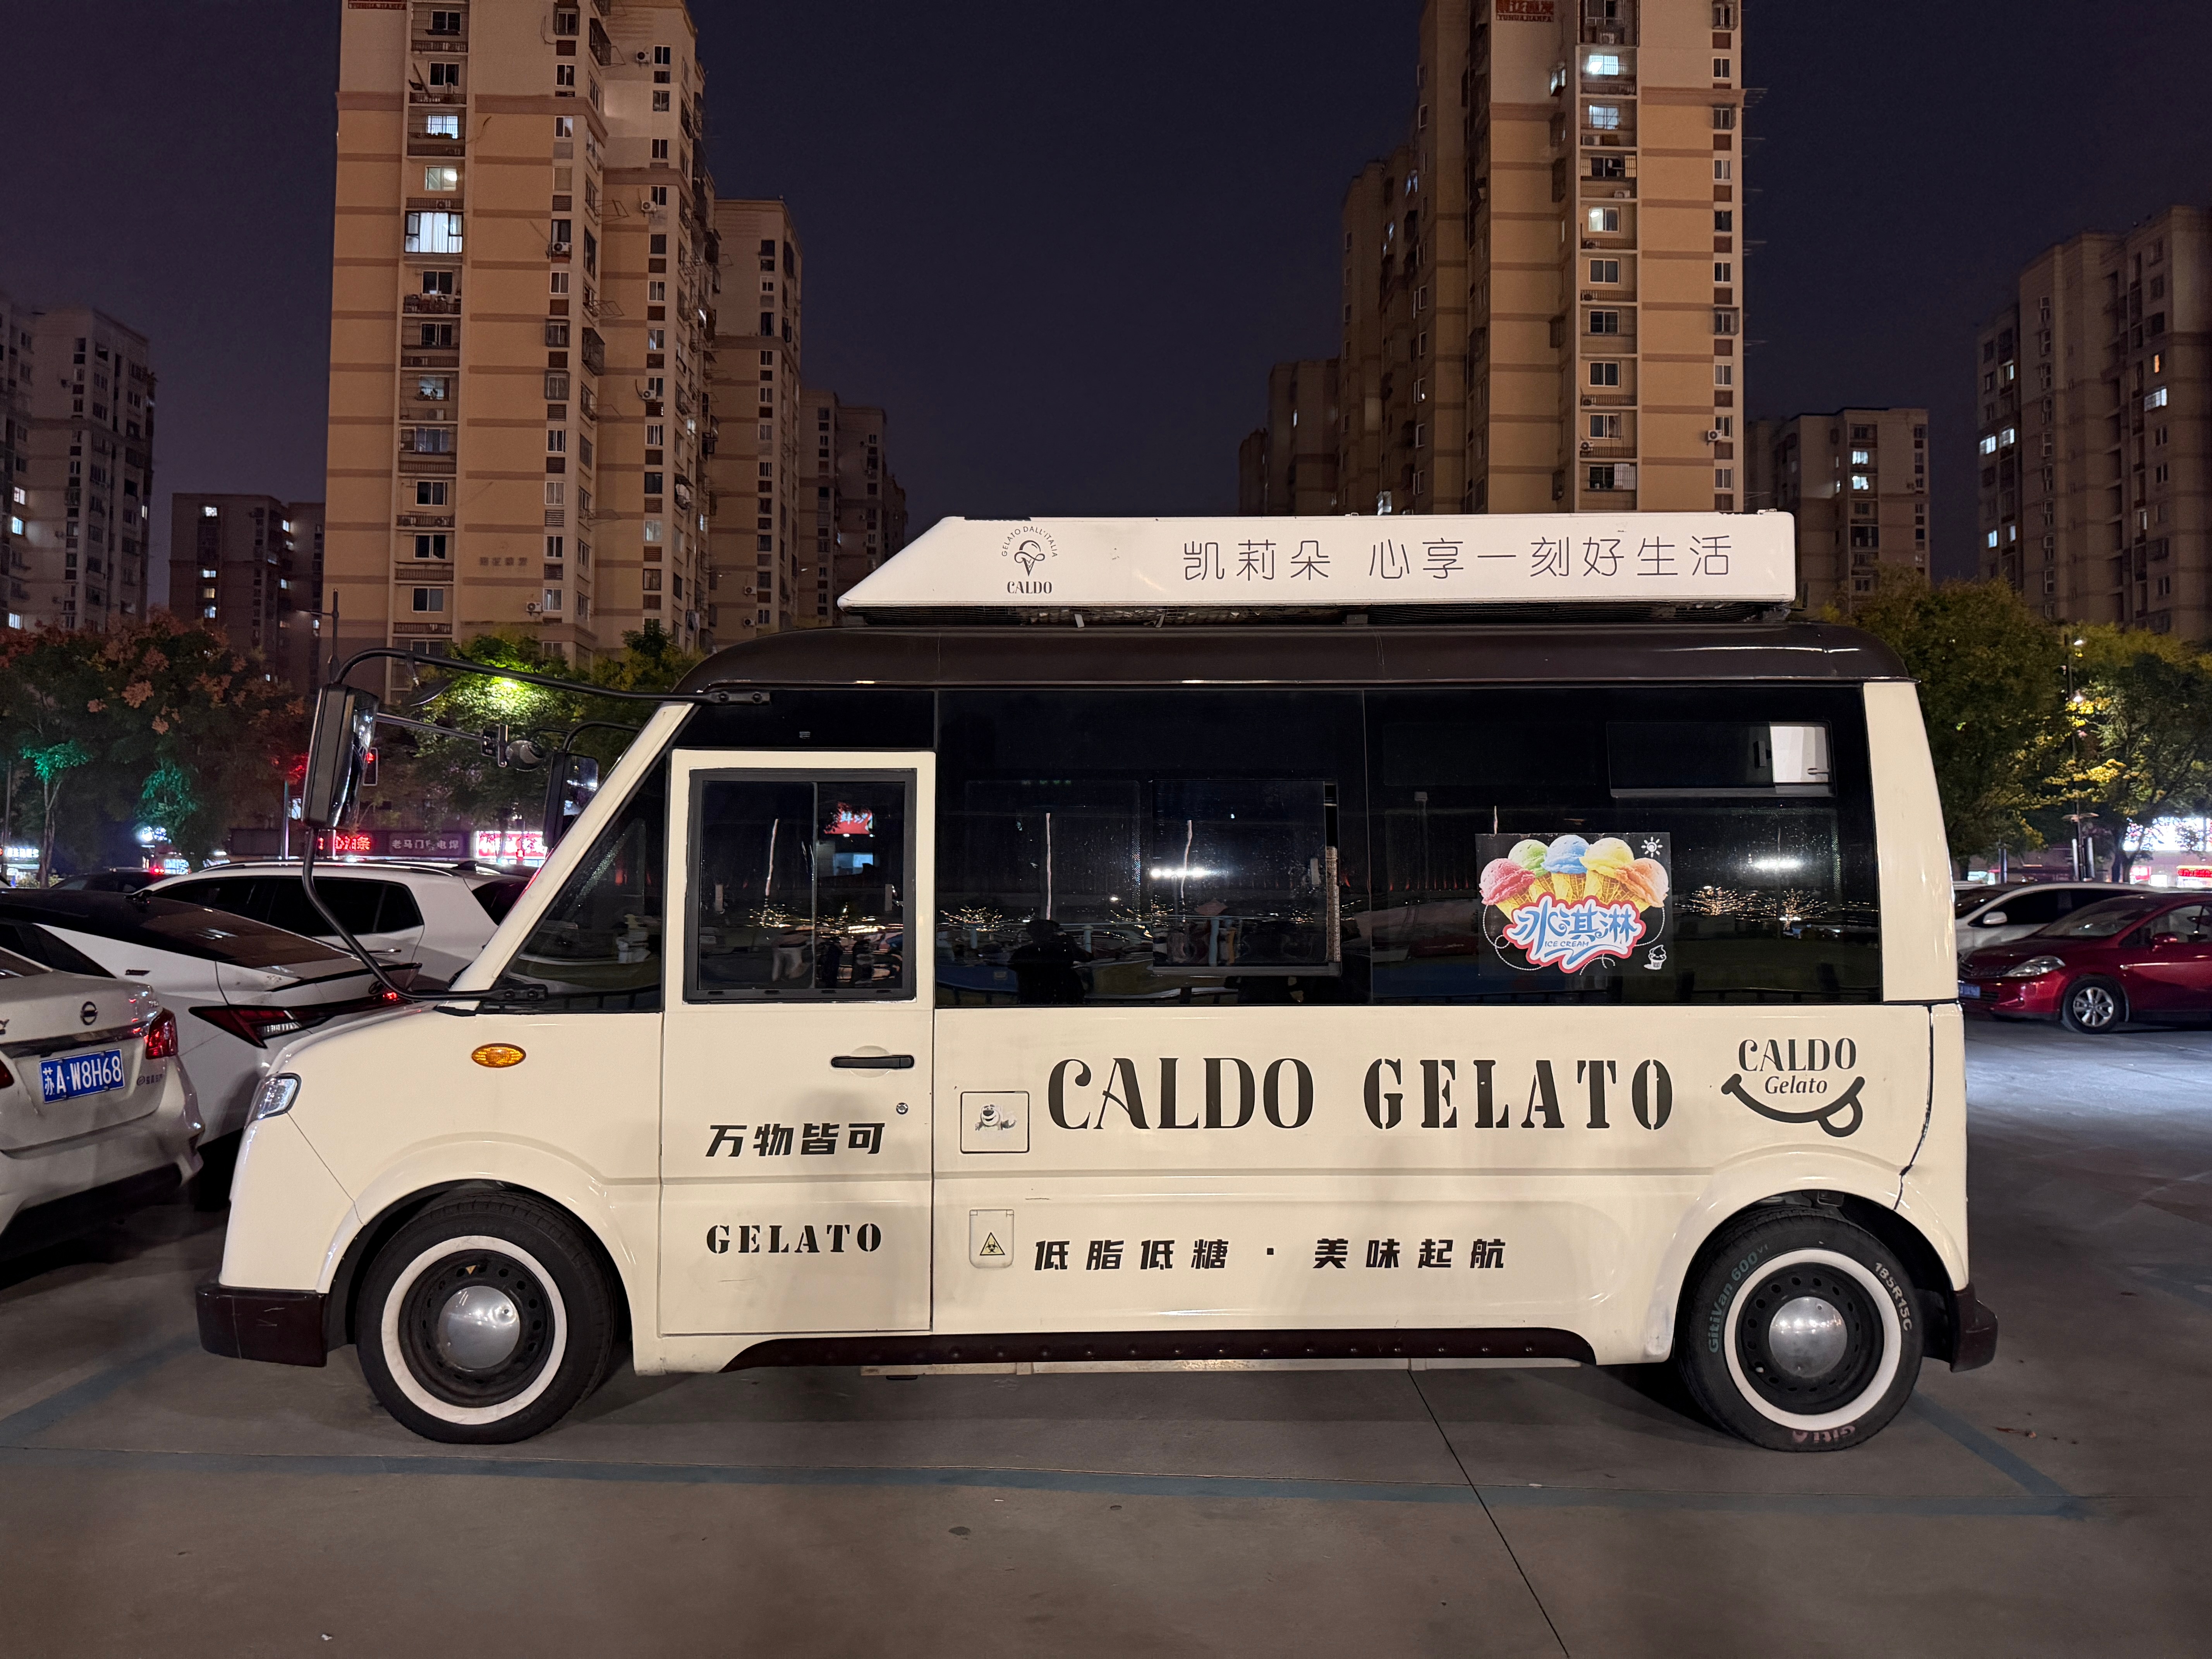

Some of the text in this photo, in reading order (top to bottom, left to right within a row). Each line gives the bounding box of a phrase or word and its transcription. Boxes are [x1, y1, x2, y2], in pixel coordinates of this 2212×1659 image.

[1001, 526, 1058, 557] GELATO DALL'ITALIA
[1183, 536, 1731, 581] 凯莉朵 心享一刻好生活
[1007, 581, 1052, 594] CALDO
[1512, 900, 1636, 955] 冰淇淋
[1739, 1038, 1856, 1071] CALDO
[1048, 1058, 1672, 1130] CALDO GELATO
[1765, 1075, 1827, 1094] Gelato
[706, 1123, 885, 1157] 万物皆可
[707, 1224, 881, 1254] GELATO
[1708, 1283, 1733, 1353] GitiVan
[1731, 1252, 1758, 1281] 600
[1875, 1262, 1912, 1331] 185R15C
